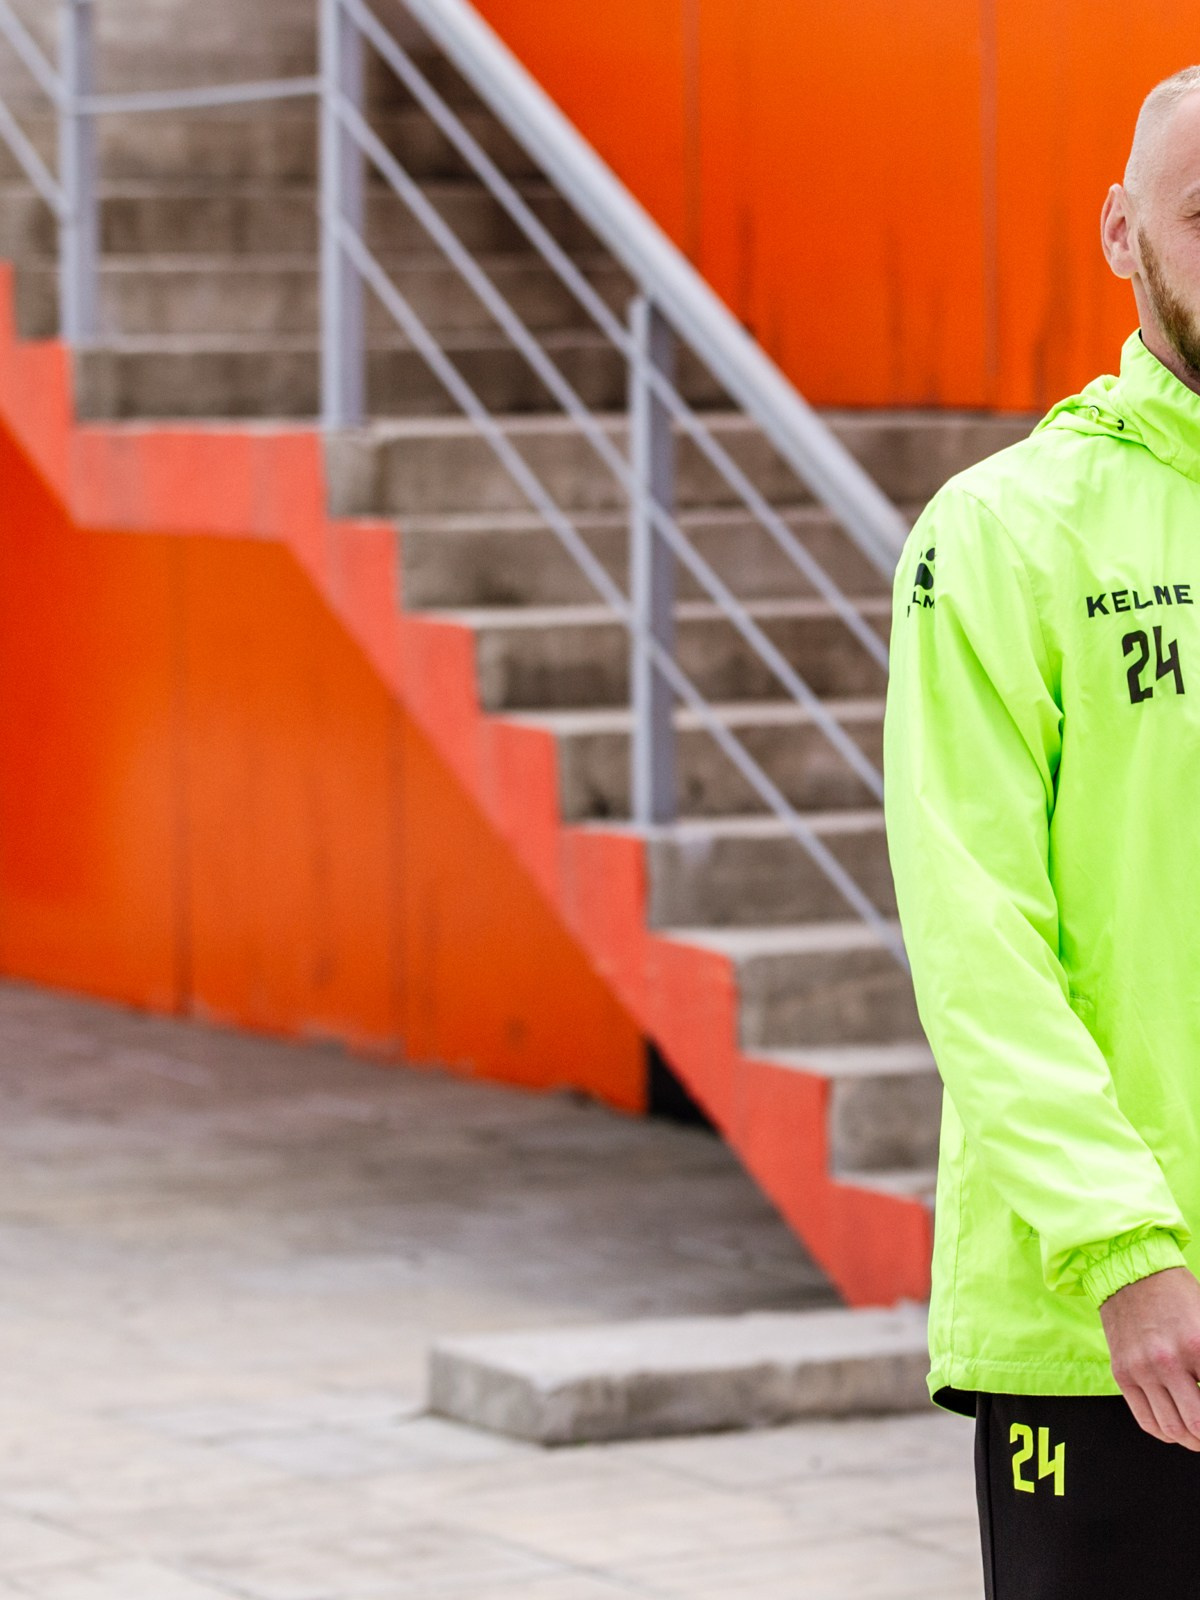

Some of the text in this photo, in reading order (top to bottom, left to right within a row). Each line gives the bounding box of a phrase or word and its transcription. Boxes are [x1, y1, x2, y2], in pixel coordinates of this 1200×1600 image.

[1086, 584, 1194, 618] KELME
[1122, 625, 1185, 704] 24
[1009, 1422, 1066, 1496] 24
